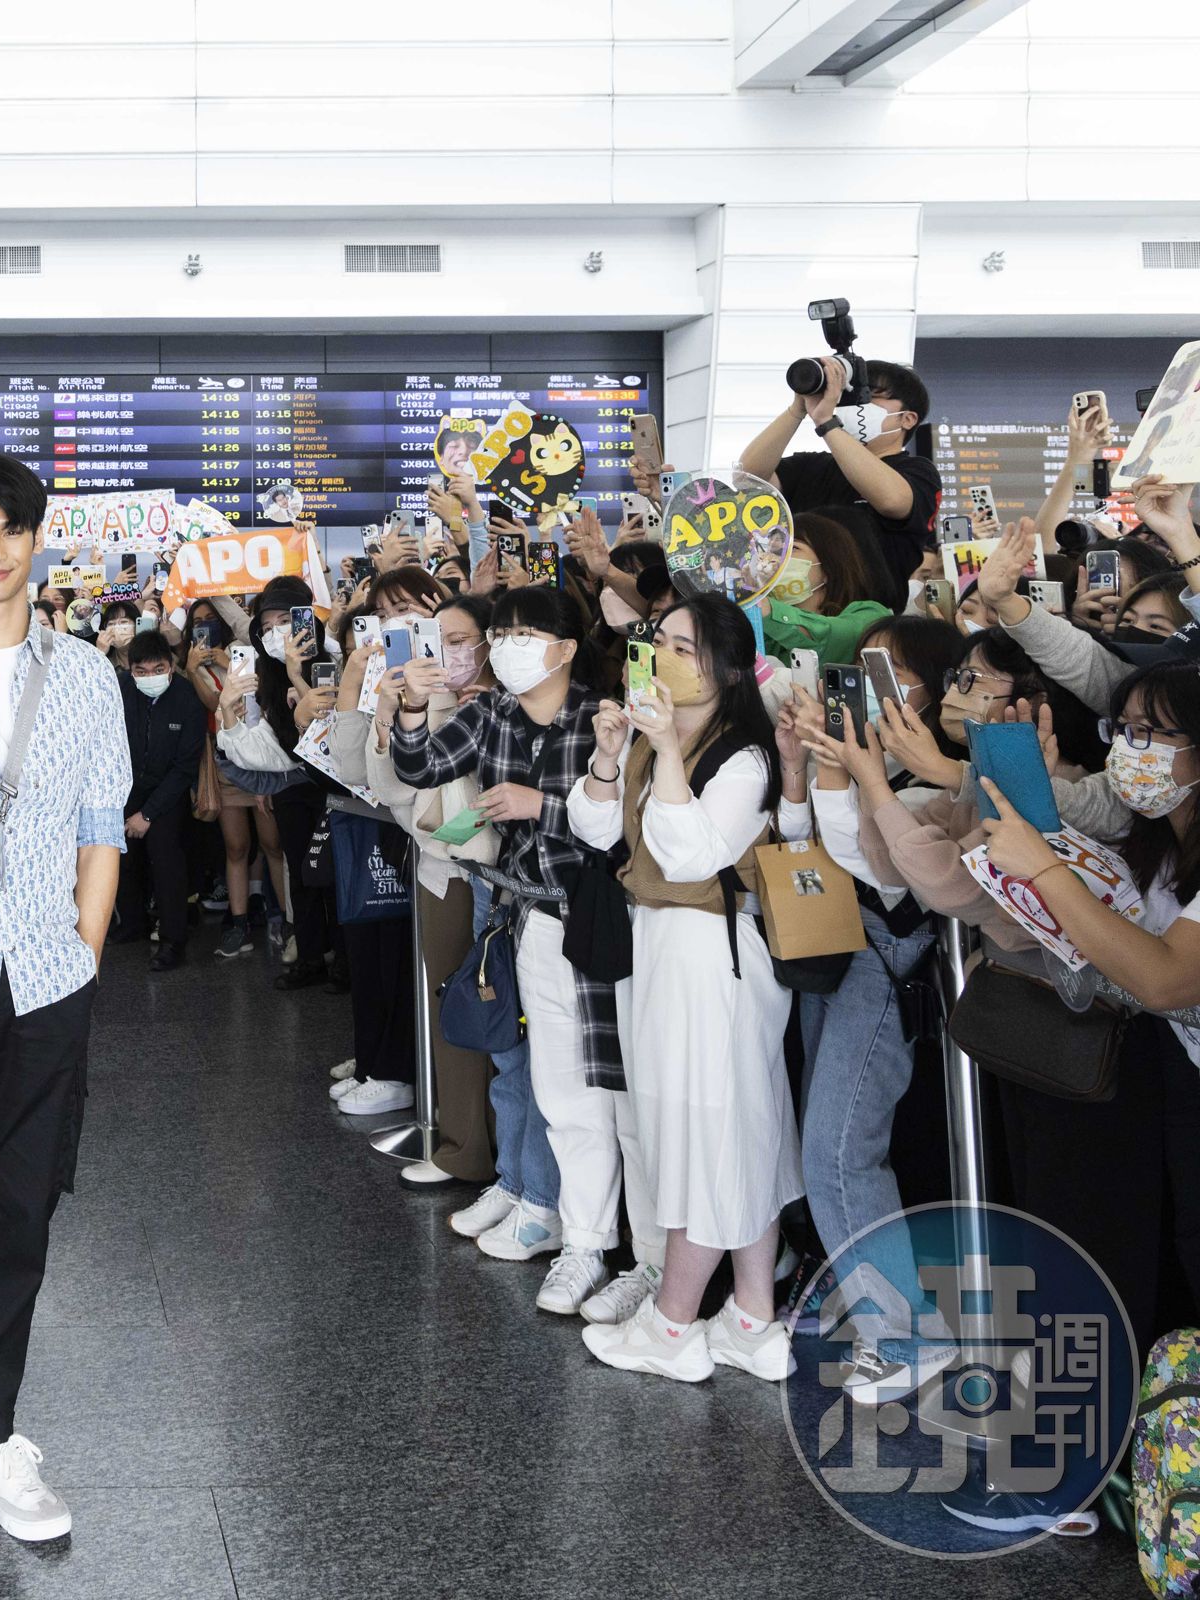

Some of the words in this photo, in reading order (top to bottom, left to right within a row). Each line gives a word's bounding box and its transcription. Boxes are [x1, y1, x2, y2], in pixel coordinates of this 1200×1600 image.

[202, 393, 239, 401] 14:03
[202, 410, 239, 418] 14:16
[256, 410, 291, 418] 16:15
[401, 409, 444, 417] CI7916
[598, 408, 634, 416] 16:41
[452, 421, 476, 431] APO
[4, 428, 39, 436] CI706
[202, 427, 239, 435] 14:55
[202, 444, 239, 452] 14:26
[471, 411, 533, 480] APO
[202, 461, 239, 469] 14:57
[256, 461, 291, 469] 16:45
[203, 478, 239, 486] 14:17
[200, 495, 240, 504] 14:16
[103, 500, 169, 539] APO
[666, 495, 780, 554] APO
[176, 535, 284, 587] APO
